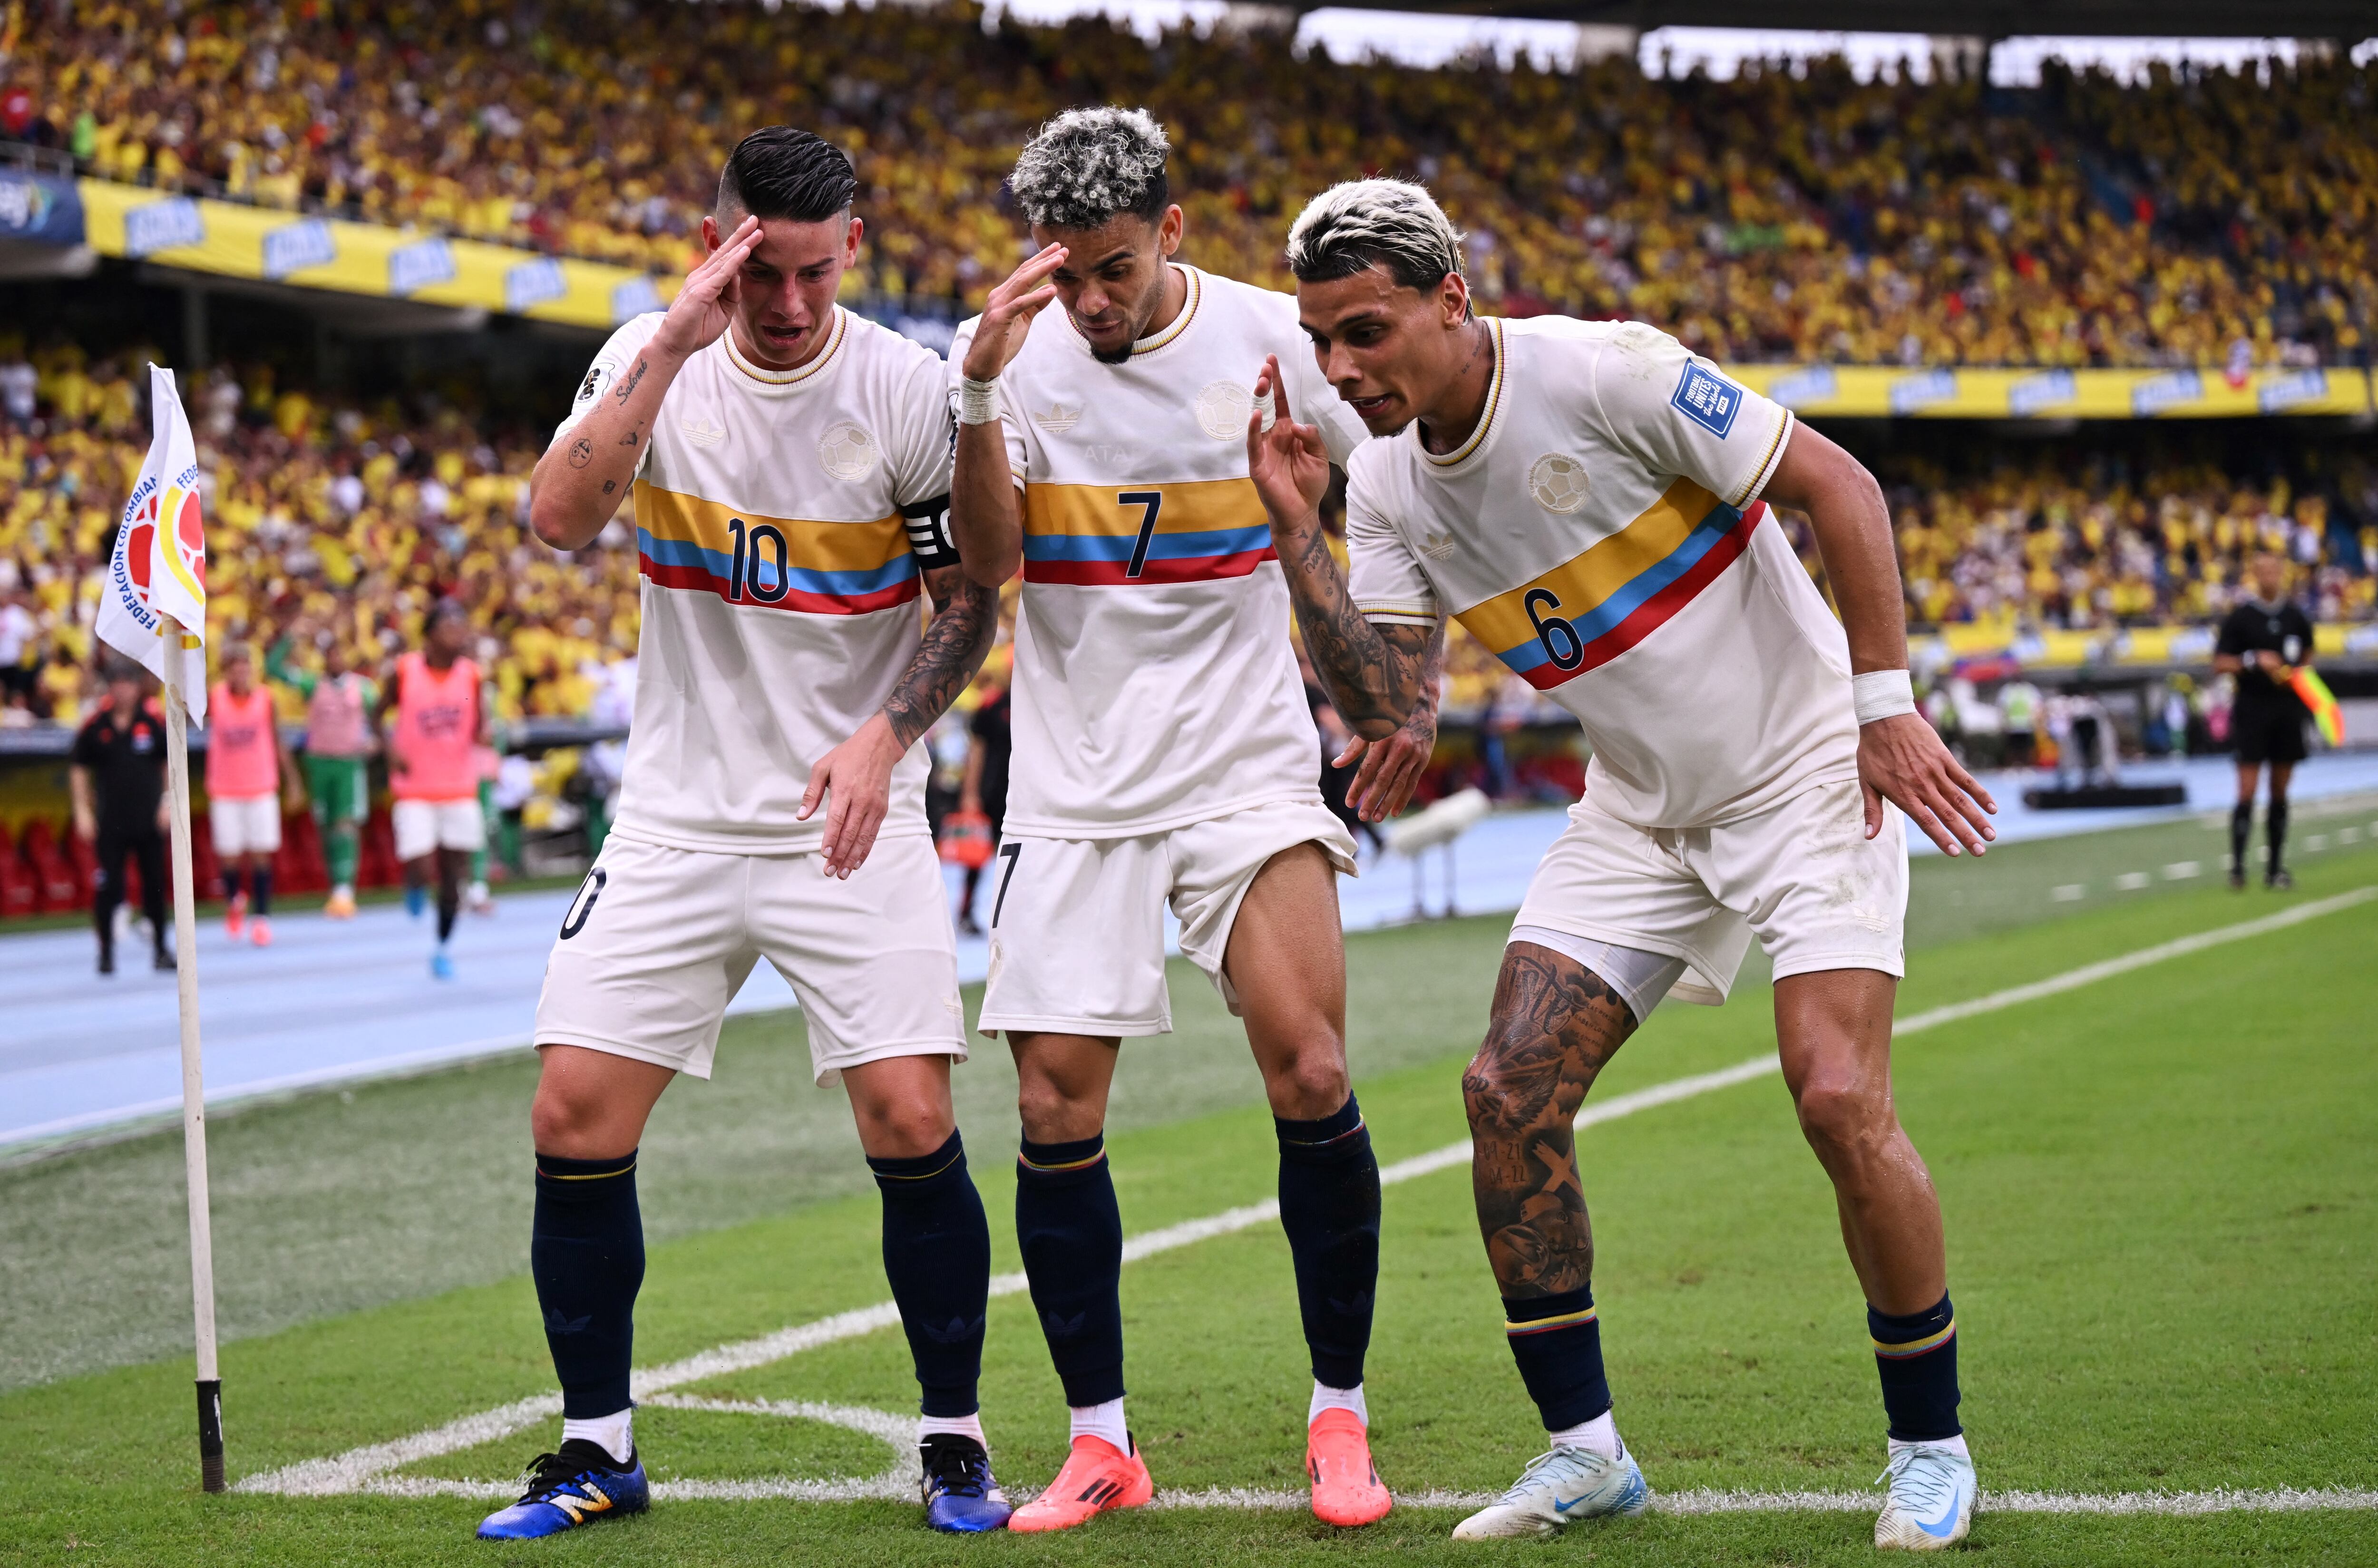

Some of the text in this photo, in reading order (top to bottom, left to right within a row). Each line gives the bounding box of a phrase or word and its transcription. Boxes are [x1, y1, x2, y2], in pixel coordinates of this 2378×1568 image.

[616, 358, 647, 406] Salomé
[1685, 373, 1702, 402] FOOTBALL
[1692, 378, 1712, 409] UNITES
[1703, 382, 1722, 417] the World
[1719, 399, 1727, 411] FIFA
[728, 517, 789, 602] 10
[1118, 491, 1161, 578] 7
[112, 551, 156, 630] FEDERACIÓN
[1523, 588, 1584, 671] 6
[992, 843, 1022, 928] 7
